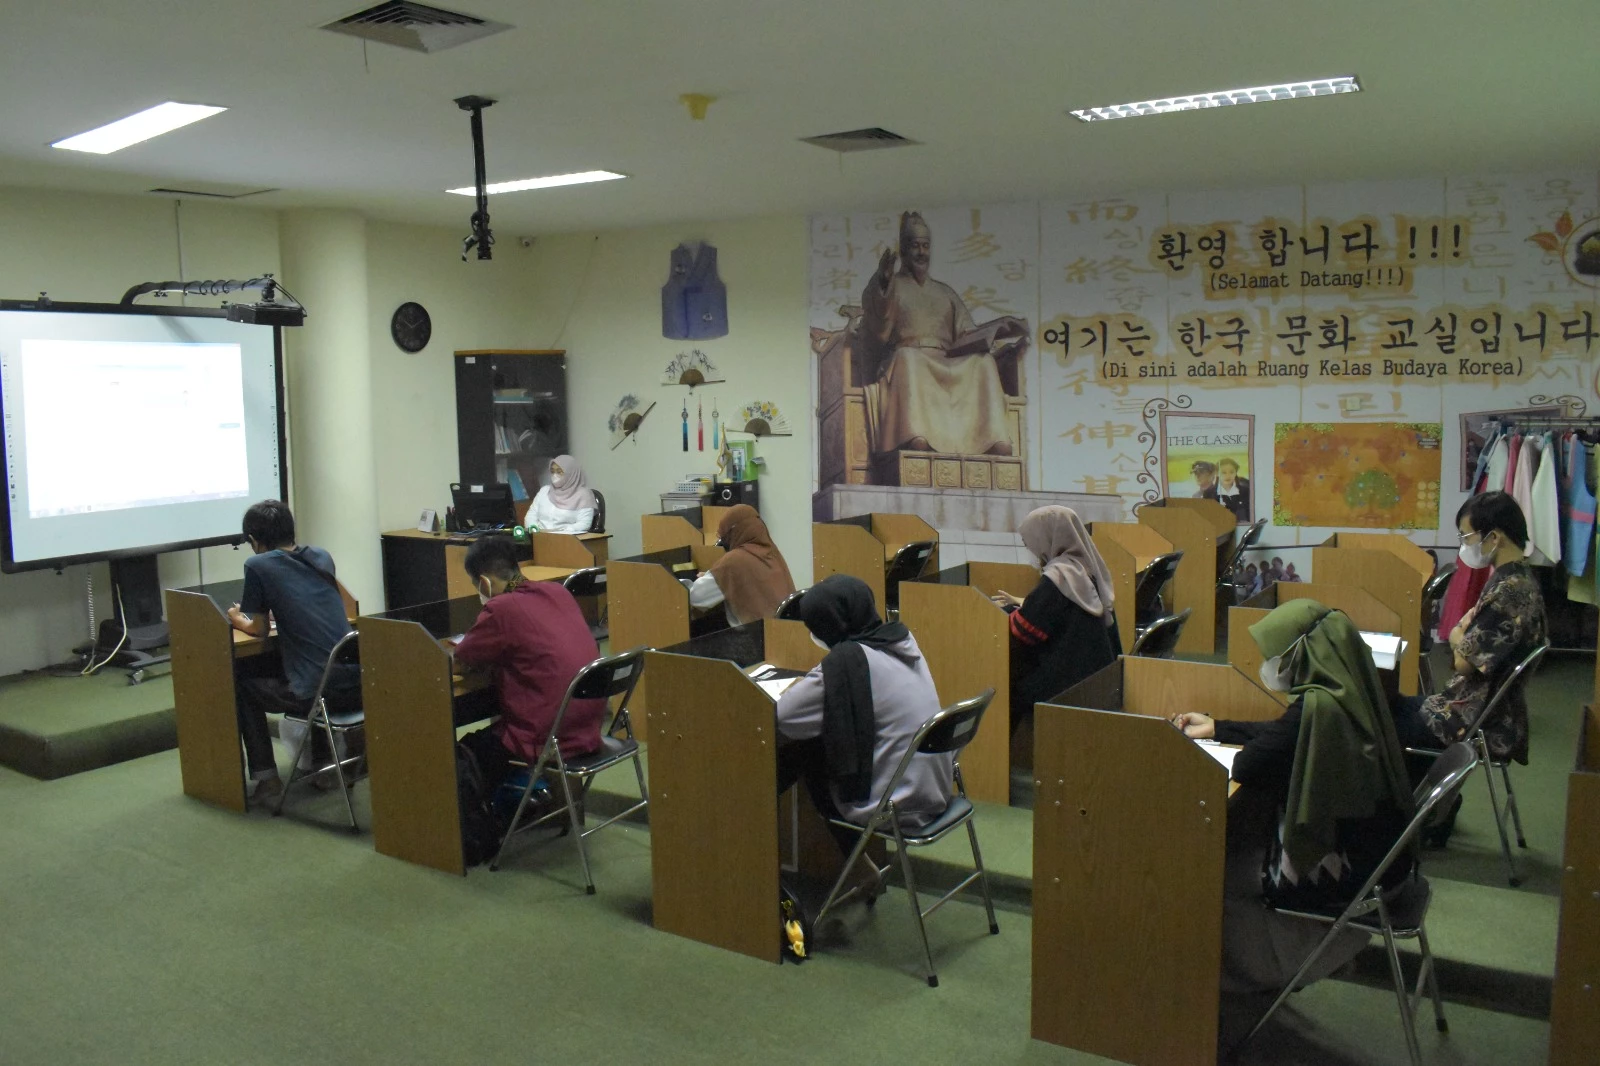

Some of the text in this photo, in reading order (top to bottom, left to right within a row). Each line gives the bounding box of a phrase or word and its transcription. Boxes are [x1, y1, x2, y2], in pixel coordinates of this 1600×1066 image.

[1157, 223, 1462, 271] 환영 합니다 !!!
[1210, 266, 1405, 292] (Selamat Datang!!!)
[1043, 310, 1600, 359] 여기는 한국 문화 교실입니다
[1102, 356, 1524, 379] (Di sini adalah Ruang Kelas Budaya Korea)
[1166, 434, 1248, 447] THE CLASSIC
